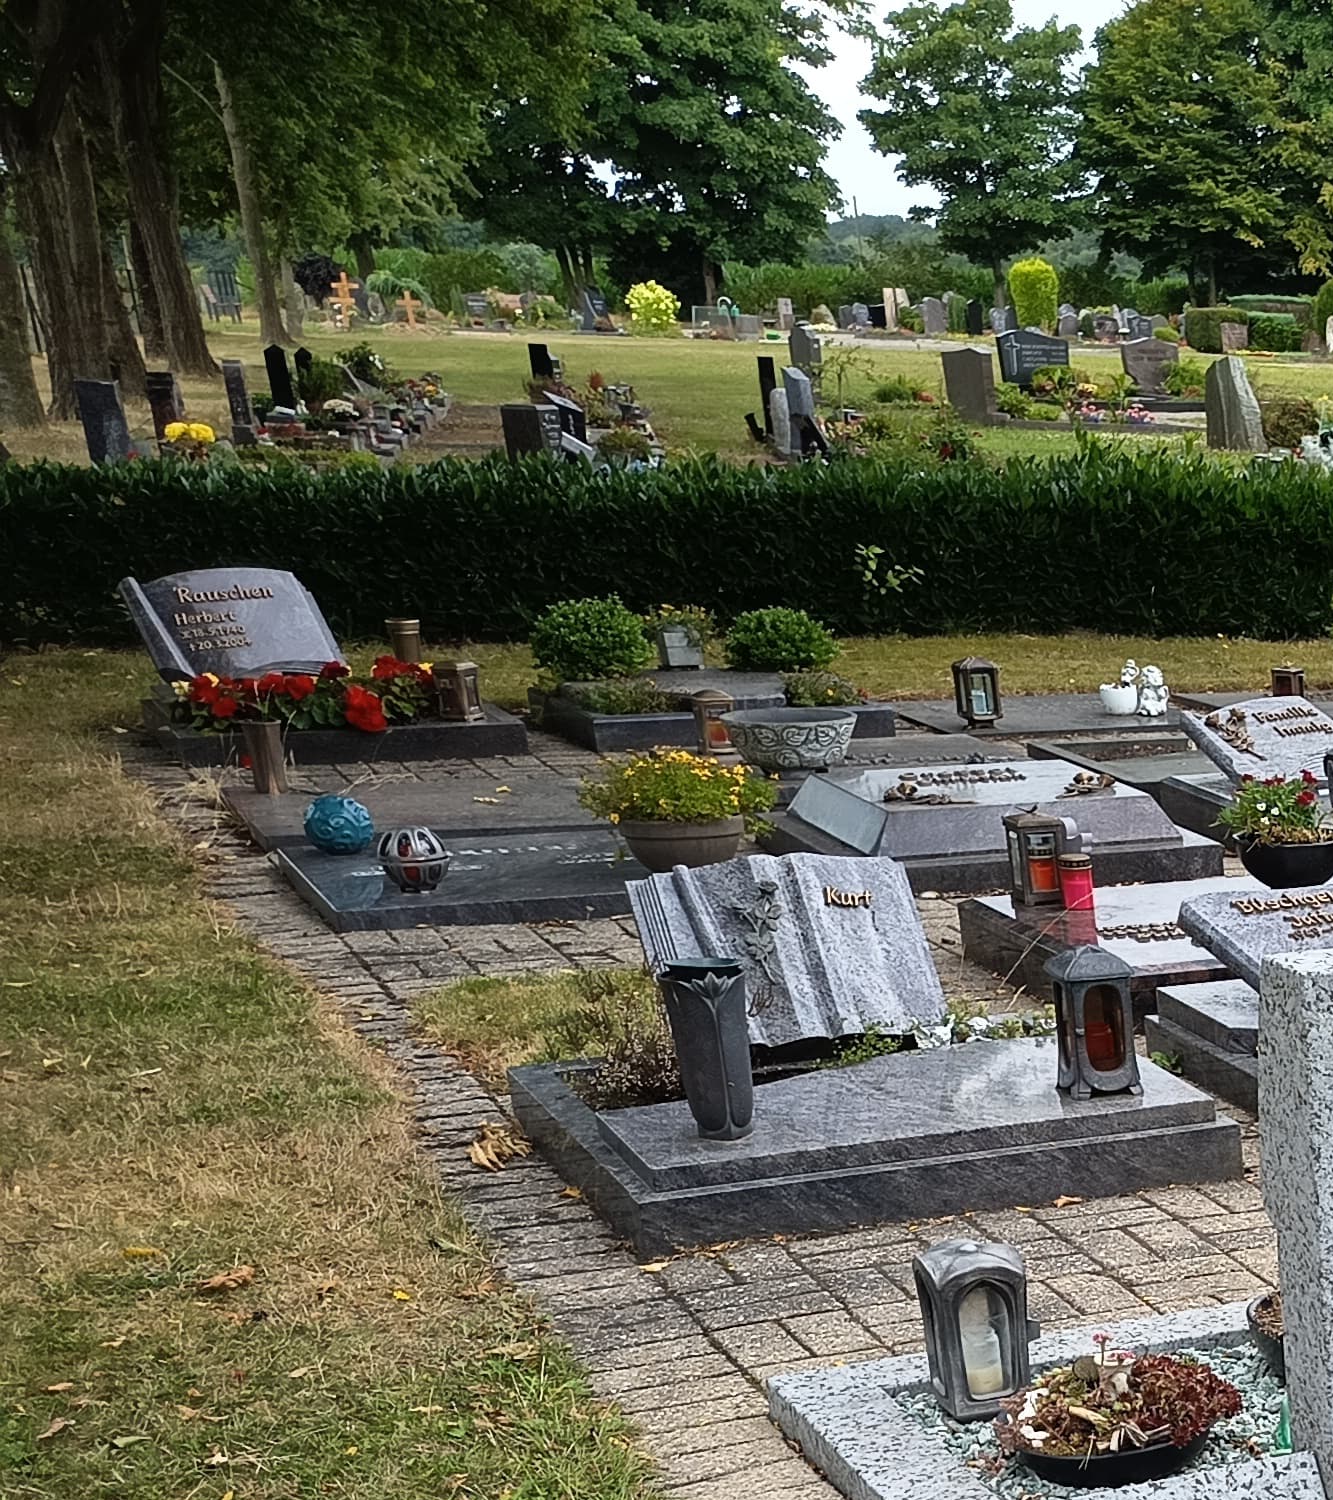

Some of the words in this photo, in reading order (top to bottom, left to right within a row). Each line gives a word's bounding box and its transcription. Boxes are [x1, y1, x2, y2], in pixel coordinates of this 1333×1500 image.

[173, 584, 274, 604] Rauschen
[174, 611, 237, 626] Herbert
[822, 885, 872, 908] Kurt
